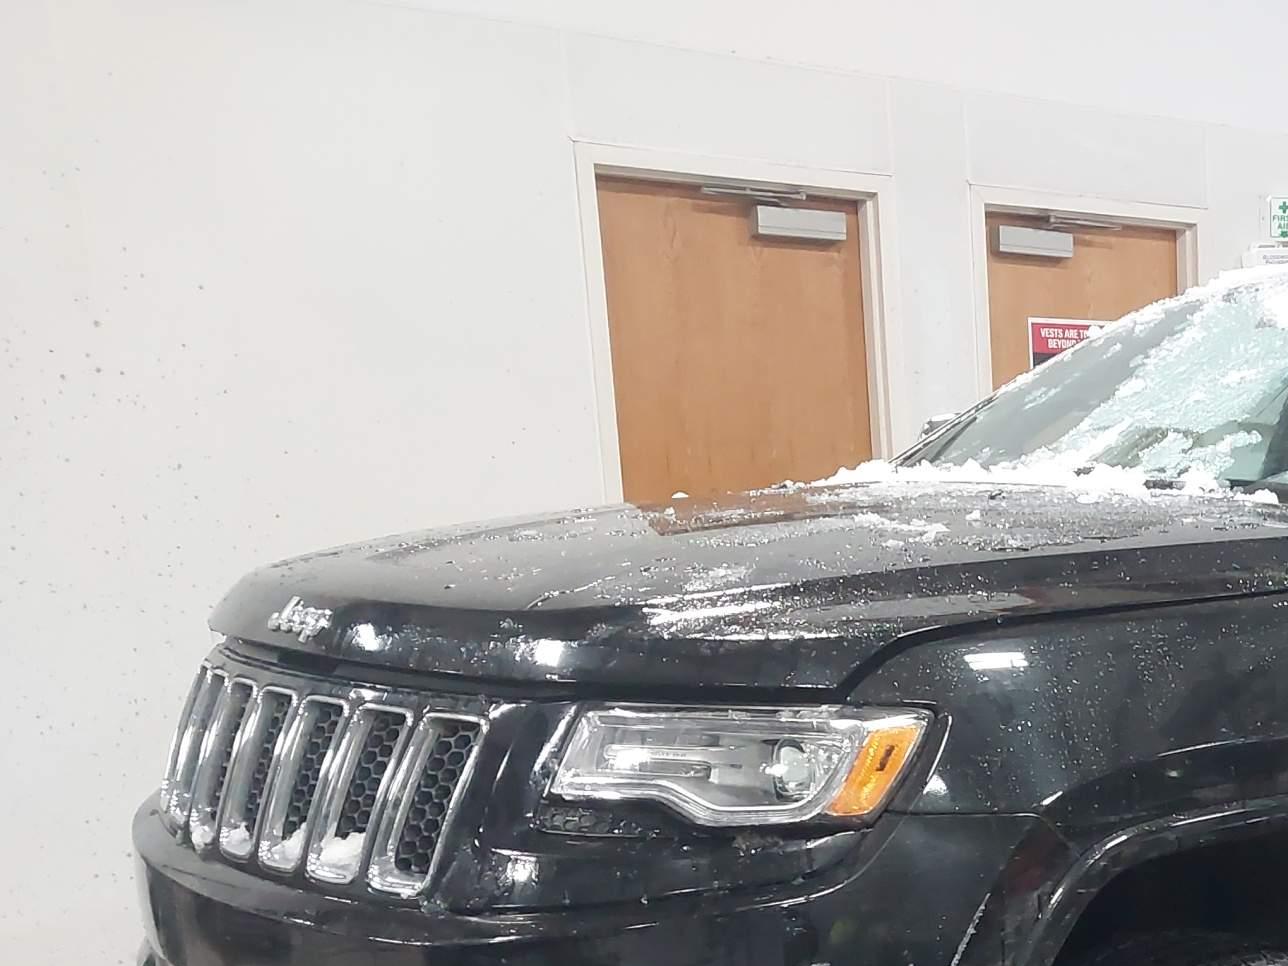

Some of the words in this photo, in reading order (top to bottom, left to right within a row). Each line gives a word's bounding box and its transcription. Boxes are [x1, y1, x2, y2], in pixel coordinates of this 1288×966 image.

[1040, 327, 1063, 338] VESTS
[1064, 328, 1079, 339] ARE
[267, 595, 333, 643] Jeep
